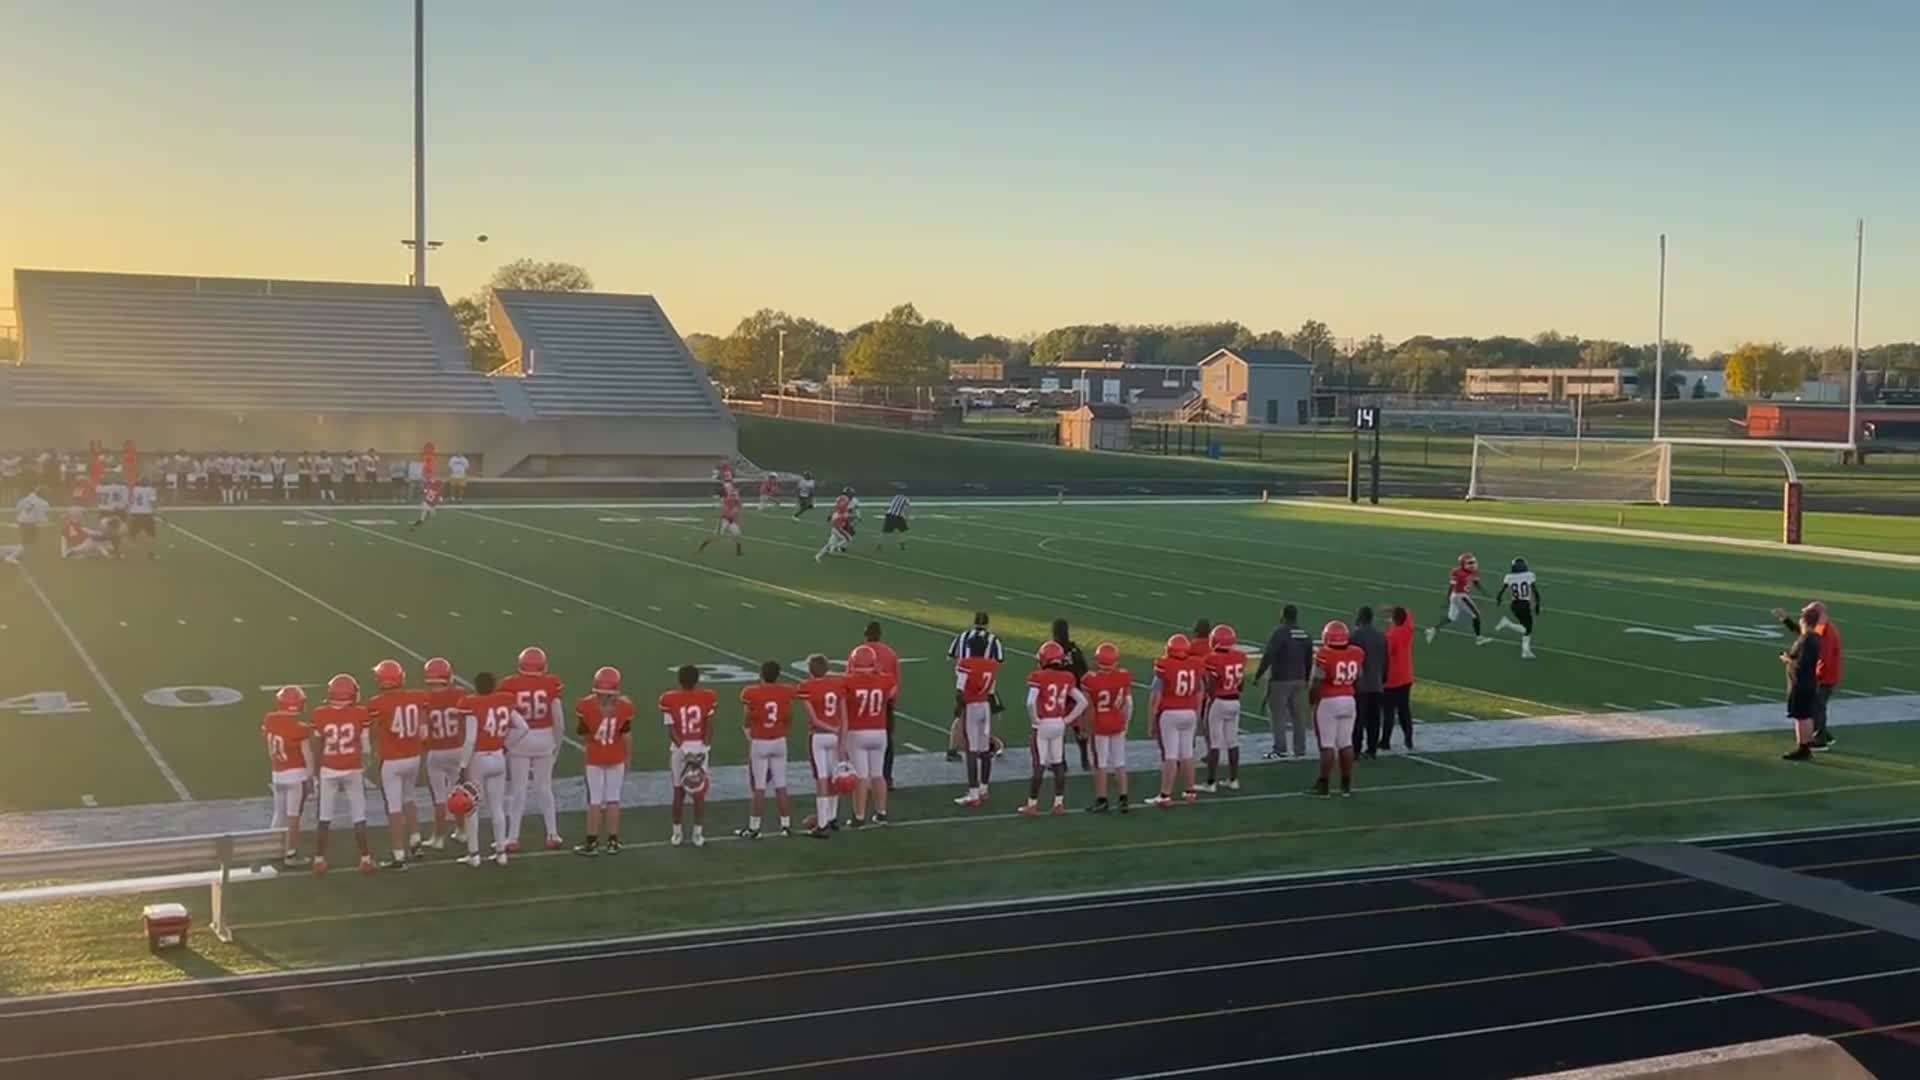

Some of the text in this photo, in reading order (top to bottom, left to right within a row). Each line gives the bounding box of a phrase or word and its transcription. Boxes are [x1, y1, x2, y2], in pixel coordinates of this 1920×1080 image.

[1356, 408, 1373, 427] 14
[1511, 581, 1529, 600] 80
[1176, 669, 1196, 697] 61
[1223, 664, 1243, 690] 55
[1333, 661, 1358, 685] 68
[516, 690, 547, 720] 56
[823, 692, 838, 717] 9
[855, 689, 884, 717] 70
[1044, 683, 1069, 711] 34
[390, 704, 418, 739] 40
[430, 708, 458, 739] 36
[483, 706, 509, 737] 42
[679, 705, 702, 734] 12
[763, 701, 778, 728] 3
[323, 722, 355, 755] 22
[594, 717, 617, 745] 41
